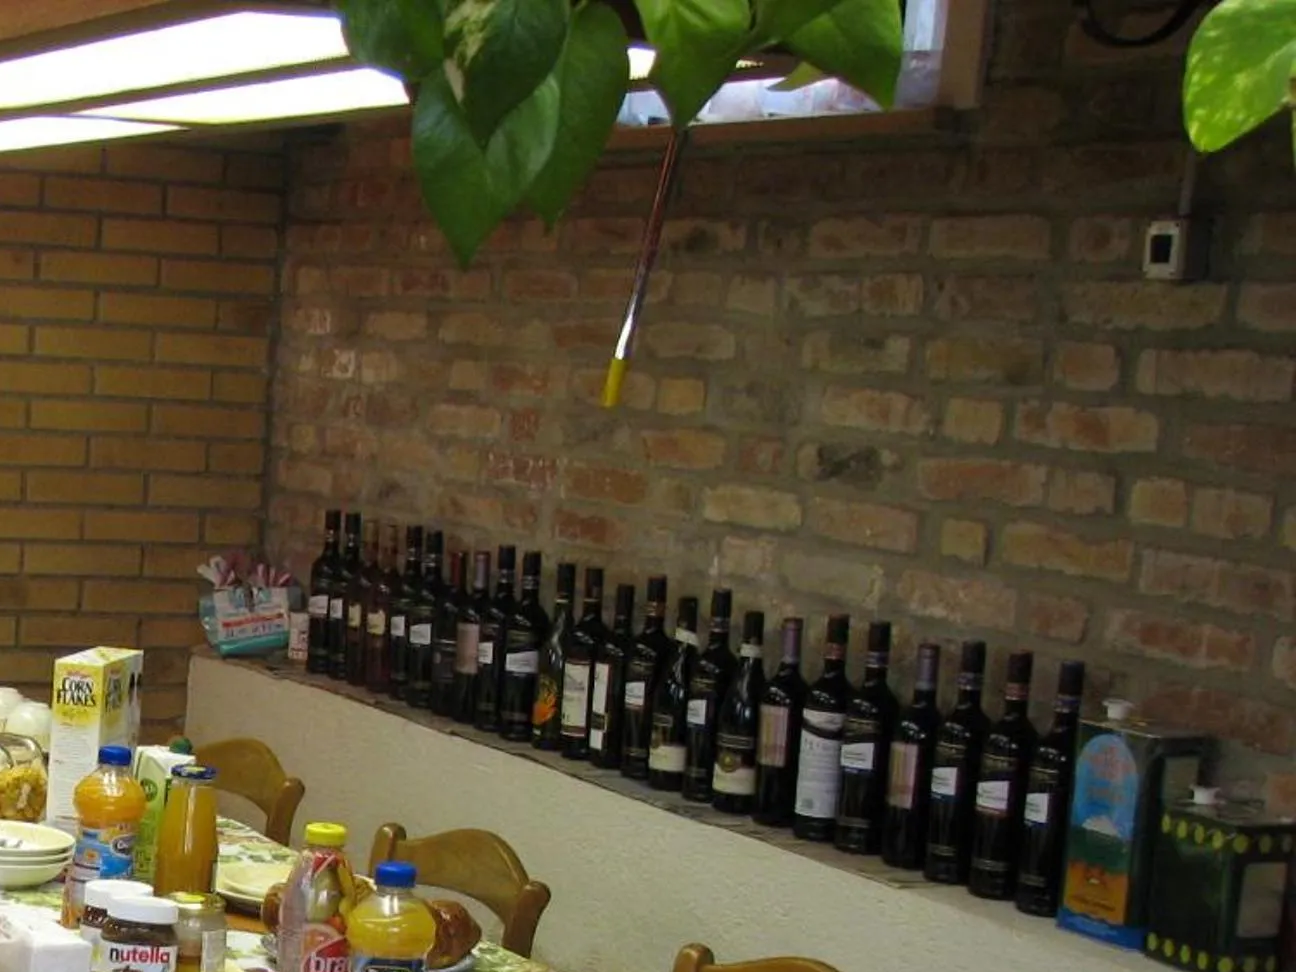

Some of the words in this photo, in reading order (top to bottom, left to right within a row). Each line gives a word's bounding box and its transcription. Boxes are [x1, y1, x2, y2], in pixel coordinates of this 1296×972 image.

[61, 676, 94, 694] CORN
[56, 689, 97, 707] FLAKES
[109, 945, 170, 964] nutella
